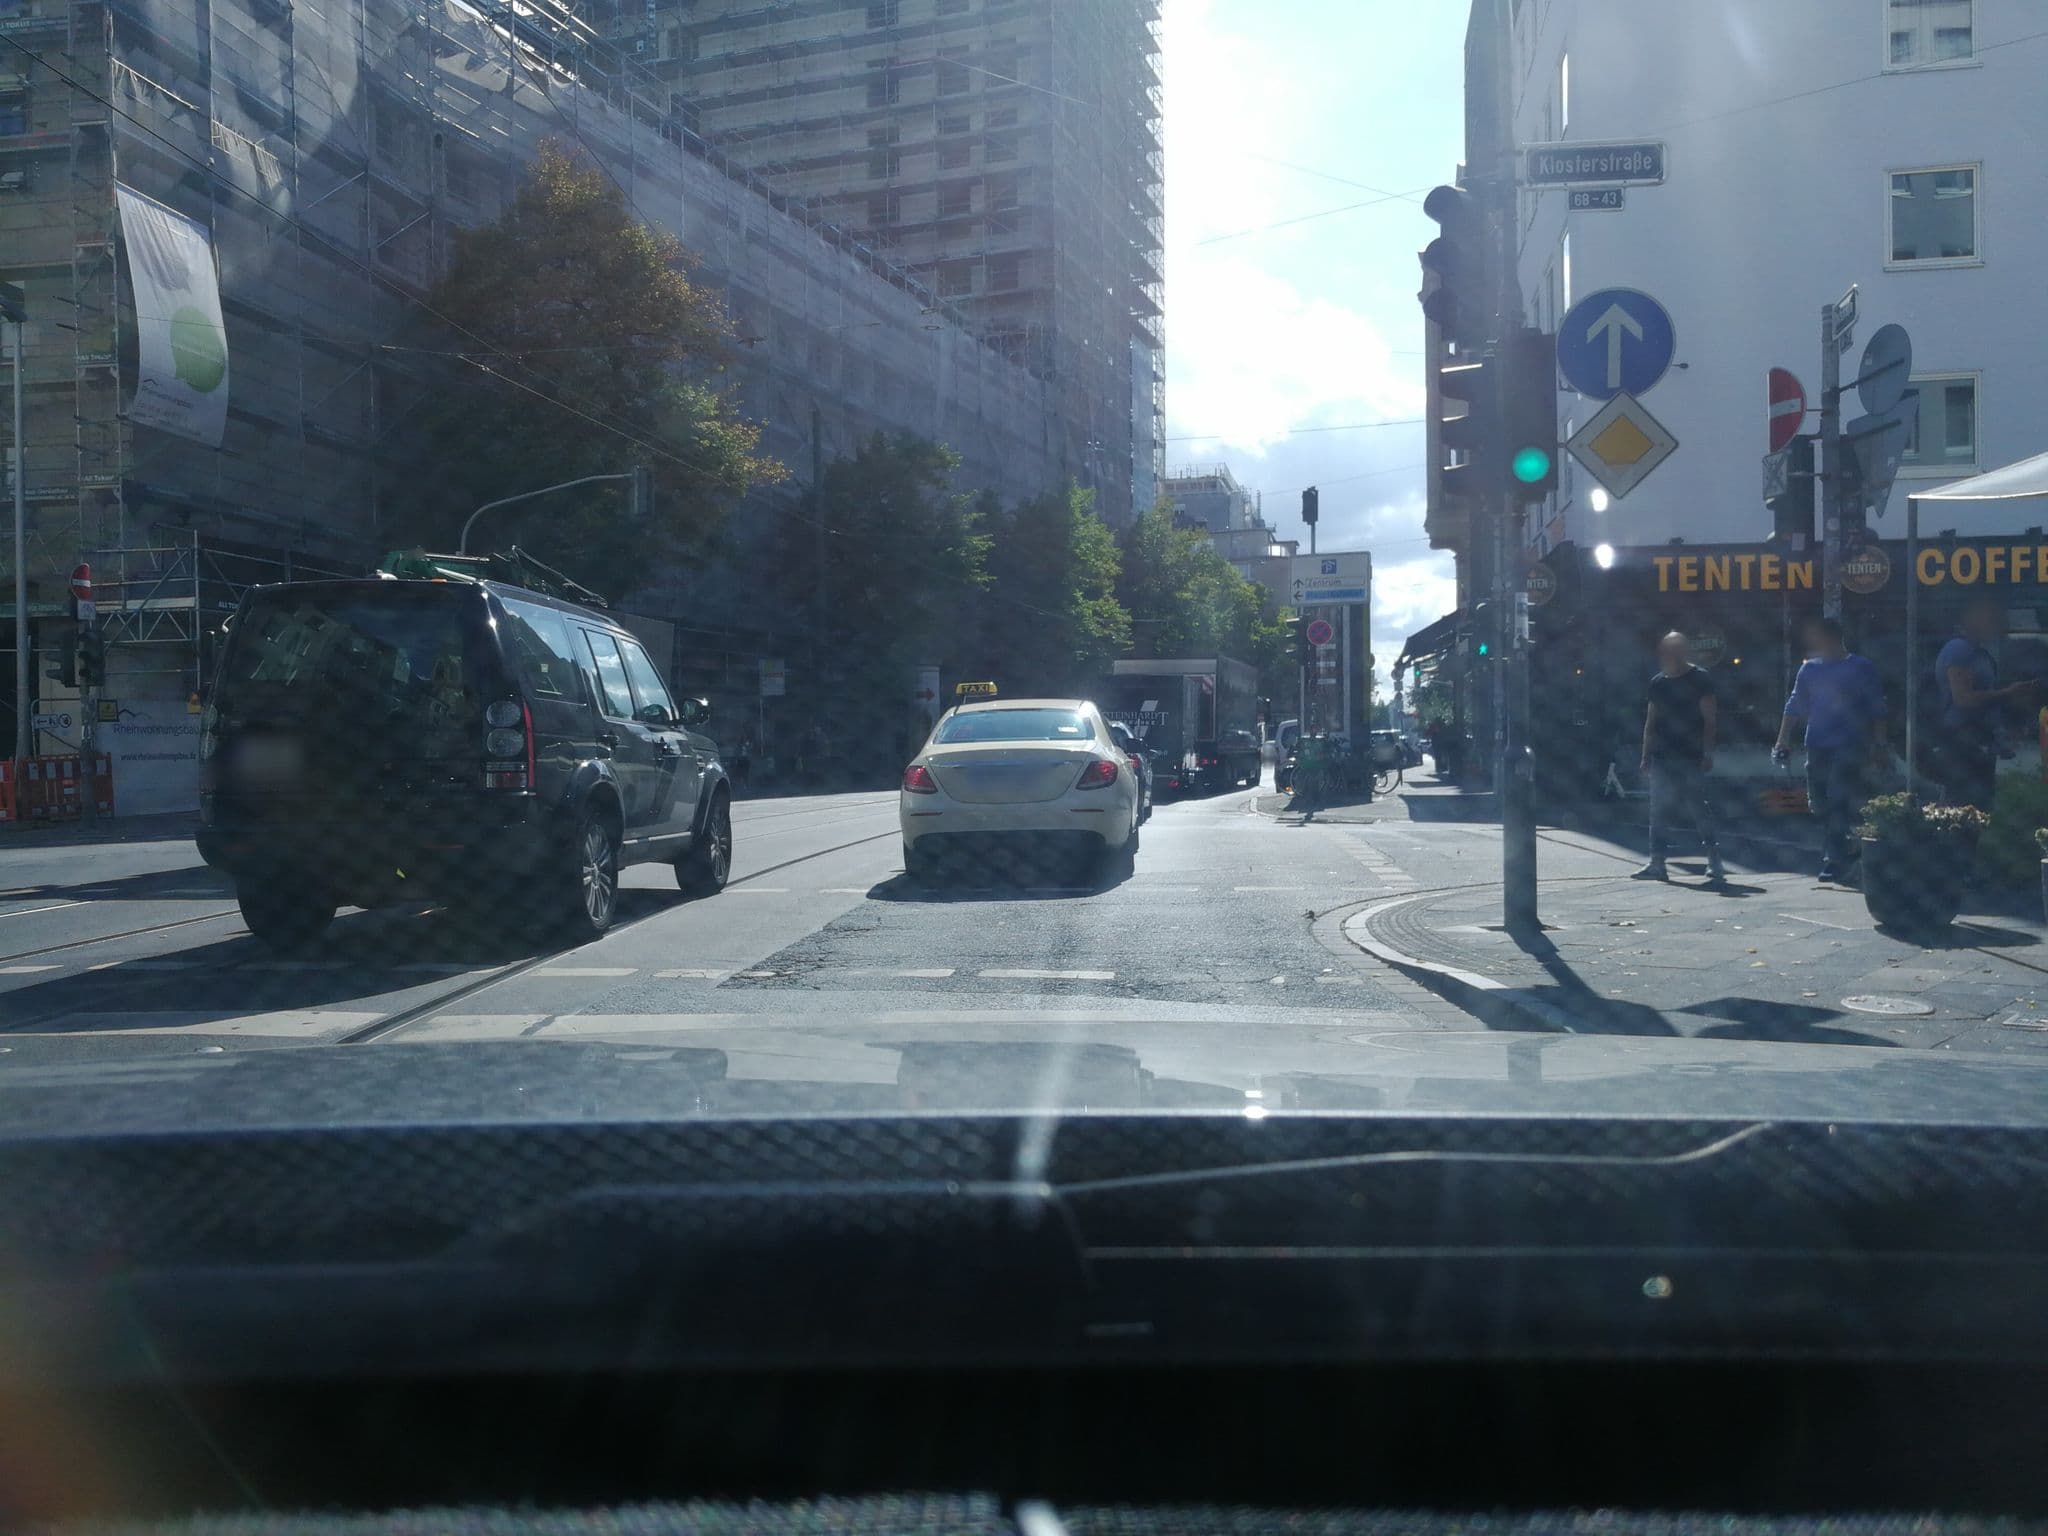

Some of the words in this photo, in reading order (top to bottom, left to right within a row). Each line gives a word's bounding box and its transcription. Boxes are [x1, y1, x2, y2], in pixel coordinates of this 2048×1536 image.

[1538, 151, 1653, 175] Klosterstraße
[1652, 552, 1814, 592] TENTEN
[1848, 562, 1881, 575] TENTEN
[963, 684, 989, 693] TAXI
